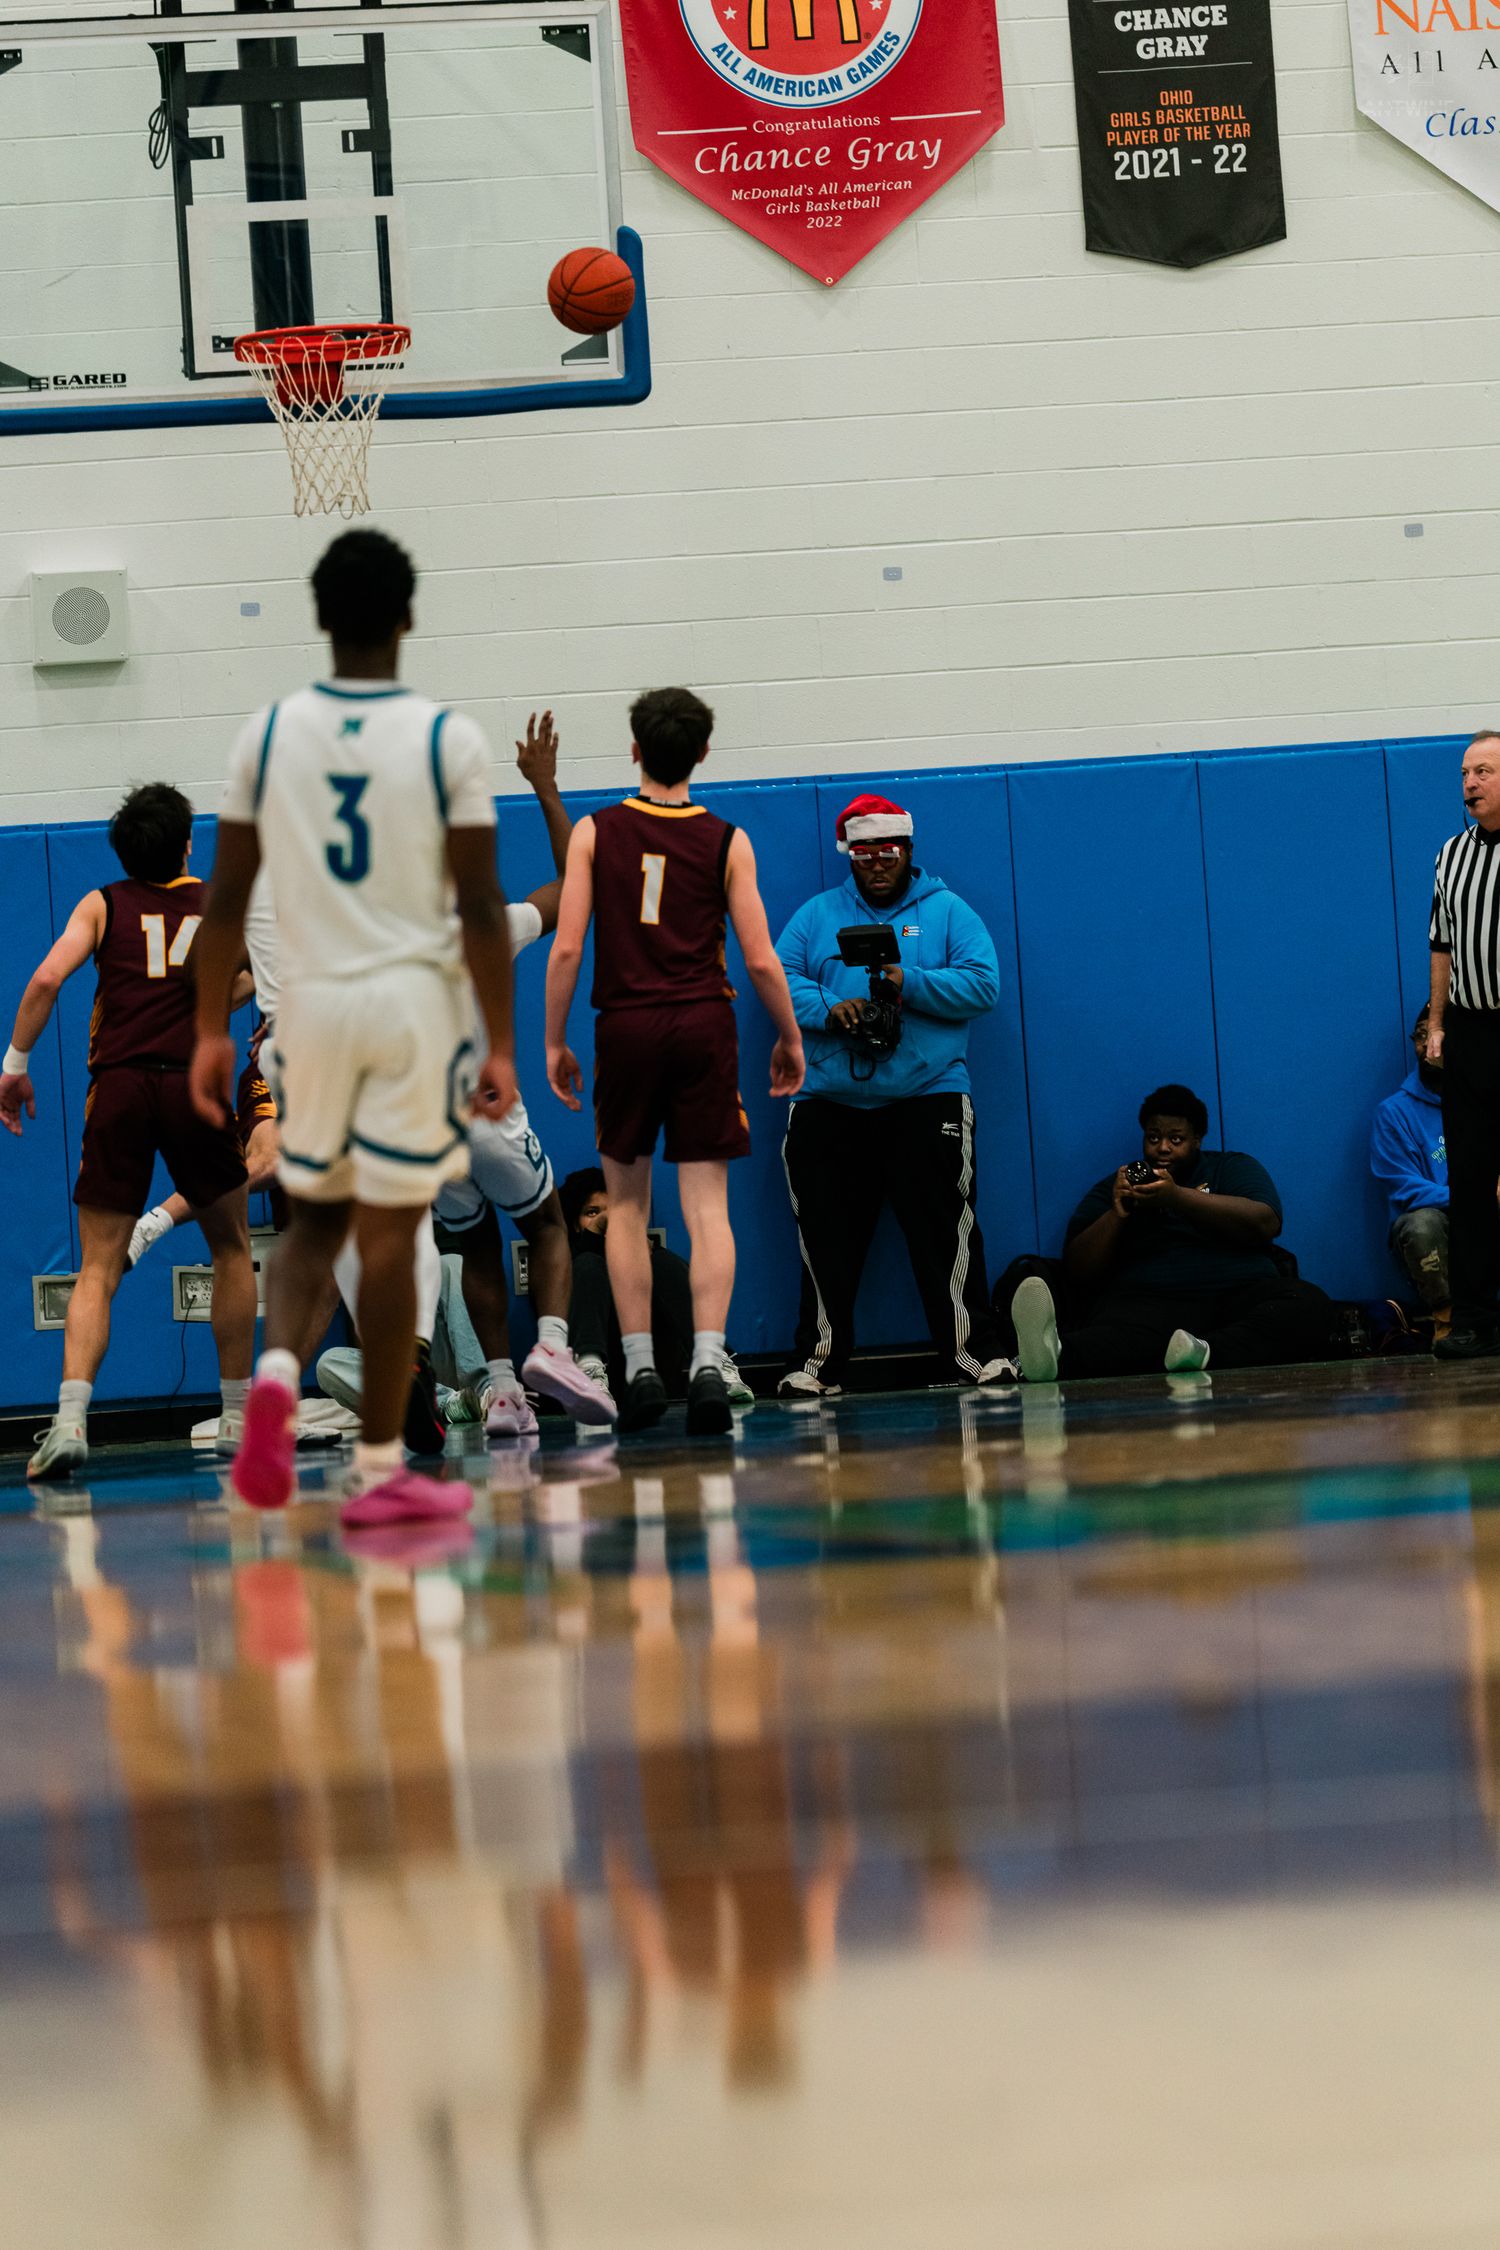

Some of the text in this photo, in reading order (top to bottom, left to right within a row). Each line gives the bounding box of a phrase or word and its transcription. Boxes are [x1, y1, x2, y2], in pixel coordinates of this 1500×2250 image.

[1114, 5, 1228, 32] CHANCE
[1136, 35, 1209, 60] GRAY
[711, 31, 900, 98] ALL AMERICAN GAMES
[1380, 49, 1444, 75] All
[1159, 90, 1194, 106] OHIO
[753, 115, 881, 136] Congratulations
[1110, 105, 1247, 128] GIRLS BASKETBALL
[1425, 108, 1500, 138] Clas
[1106, 122, 1251, 147] PLAYER OF THE YEAR
[694, 137, 942, 174] Chance Gray
[1113, 147, 1181, 181] 2021
[1213, 143, 1248, 174] 22
[731, 179, 912, 201] McDonald's All American
[765, 196, 881, 216] Girls Basketball
[806, 215, 843, 229] 2022
[53, 373, 127, 385] GARED
[326, 773, 370, 883] 3
[640, 852, 666, 925] 1
